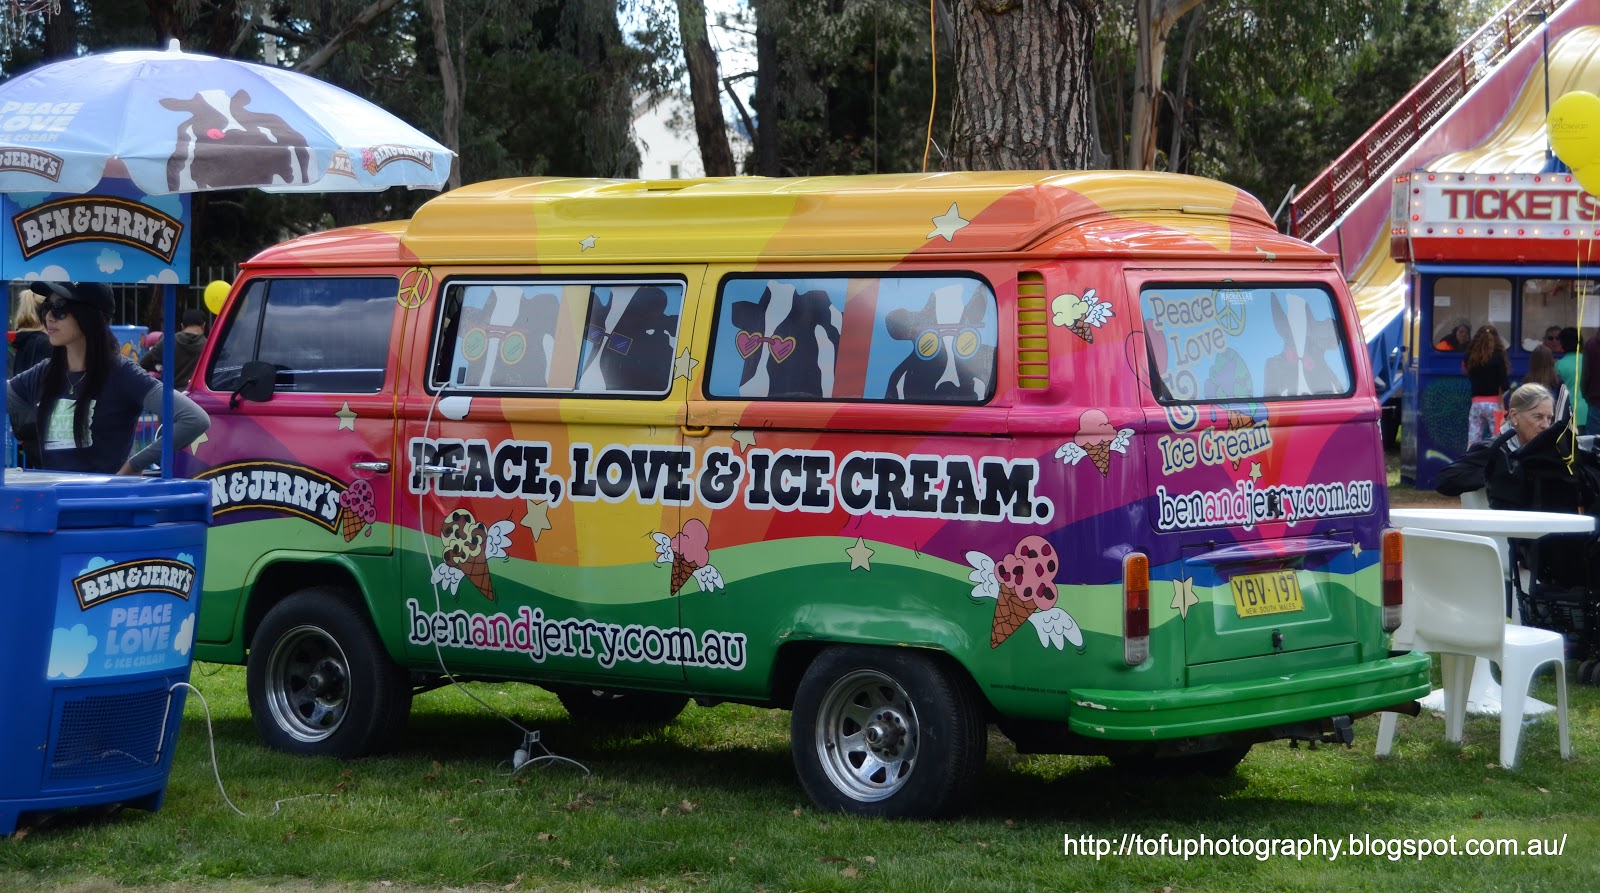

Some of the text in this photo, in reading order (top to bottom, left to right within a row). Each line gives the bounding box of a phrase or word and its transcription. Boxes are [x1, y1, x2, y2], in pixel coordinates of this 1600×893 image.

[0, 101, 85, 115] PEACE
[0, 115, 75, 132] OVE
[0, 151, 58, 176] JERRY'S
[1441, 189, 1600, 221] TICKETS
[1150, 295, 1214, 328] Peace
[1170, 327, 1226, 367] Love
[1160, 422, 1272, 472] Ice Cream
[211, 470, 341, 520] N&JERRY'S
[411, 442, 1049, 519] PEACE, LOVE & ICE CREAM.
[1157, 481, 1372, 528] benandjerry.com.au
[110, 603, 173, 628] PEACE
[1245, 602, 1296, 614] NEW SOUTH WALES
[105, 624, 171, 656] LOVE
[408, 601, 746, 667] benandjerry.com.au
[114, 655, 132, 669] ICE
